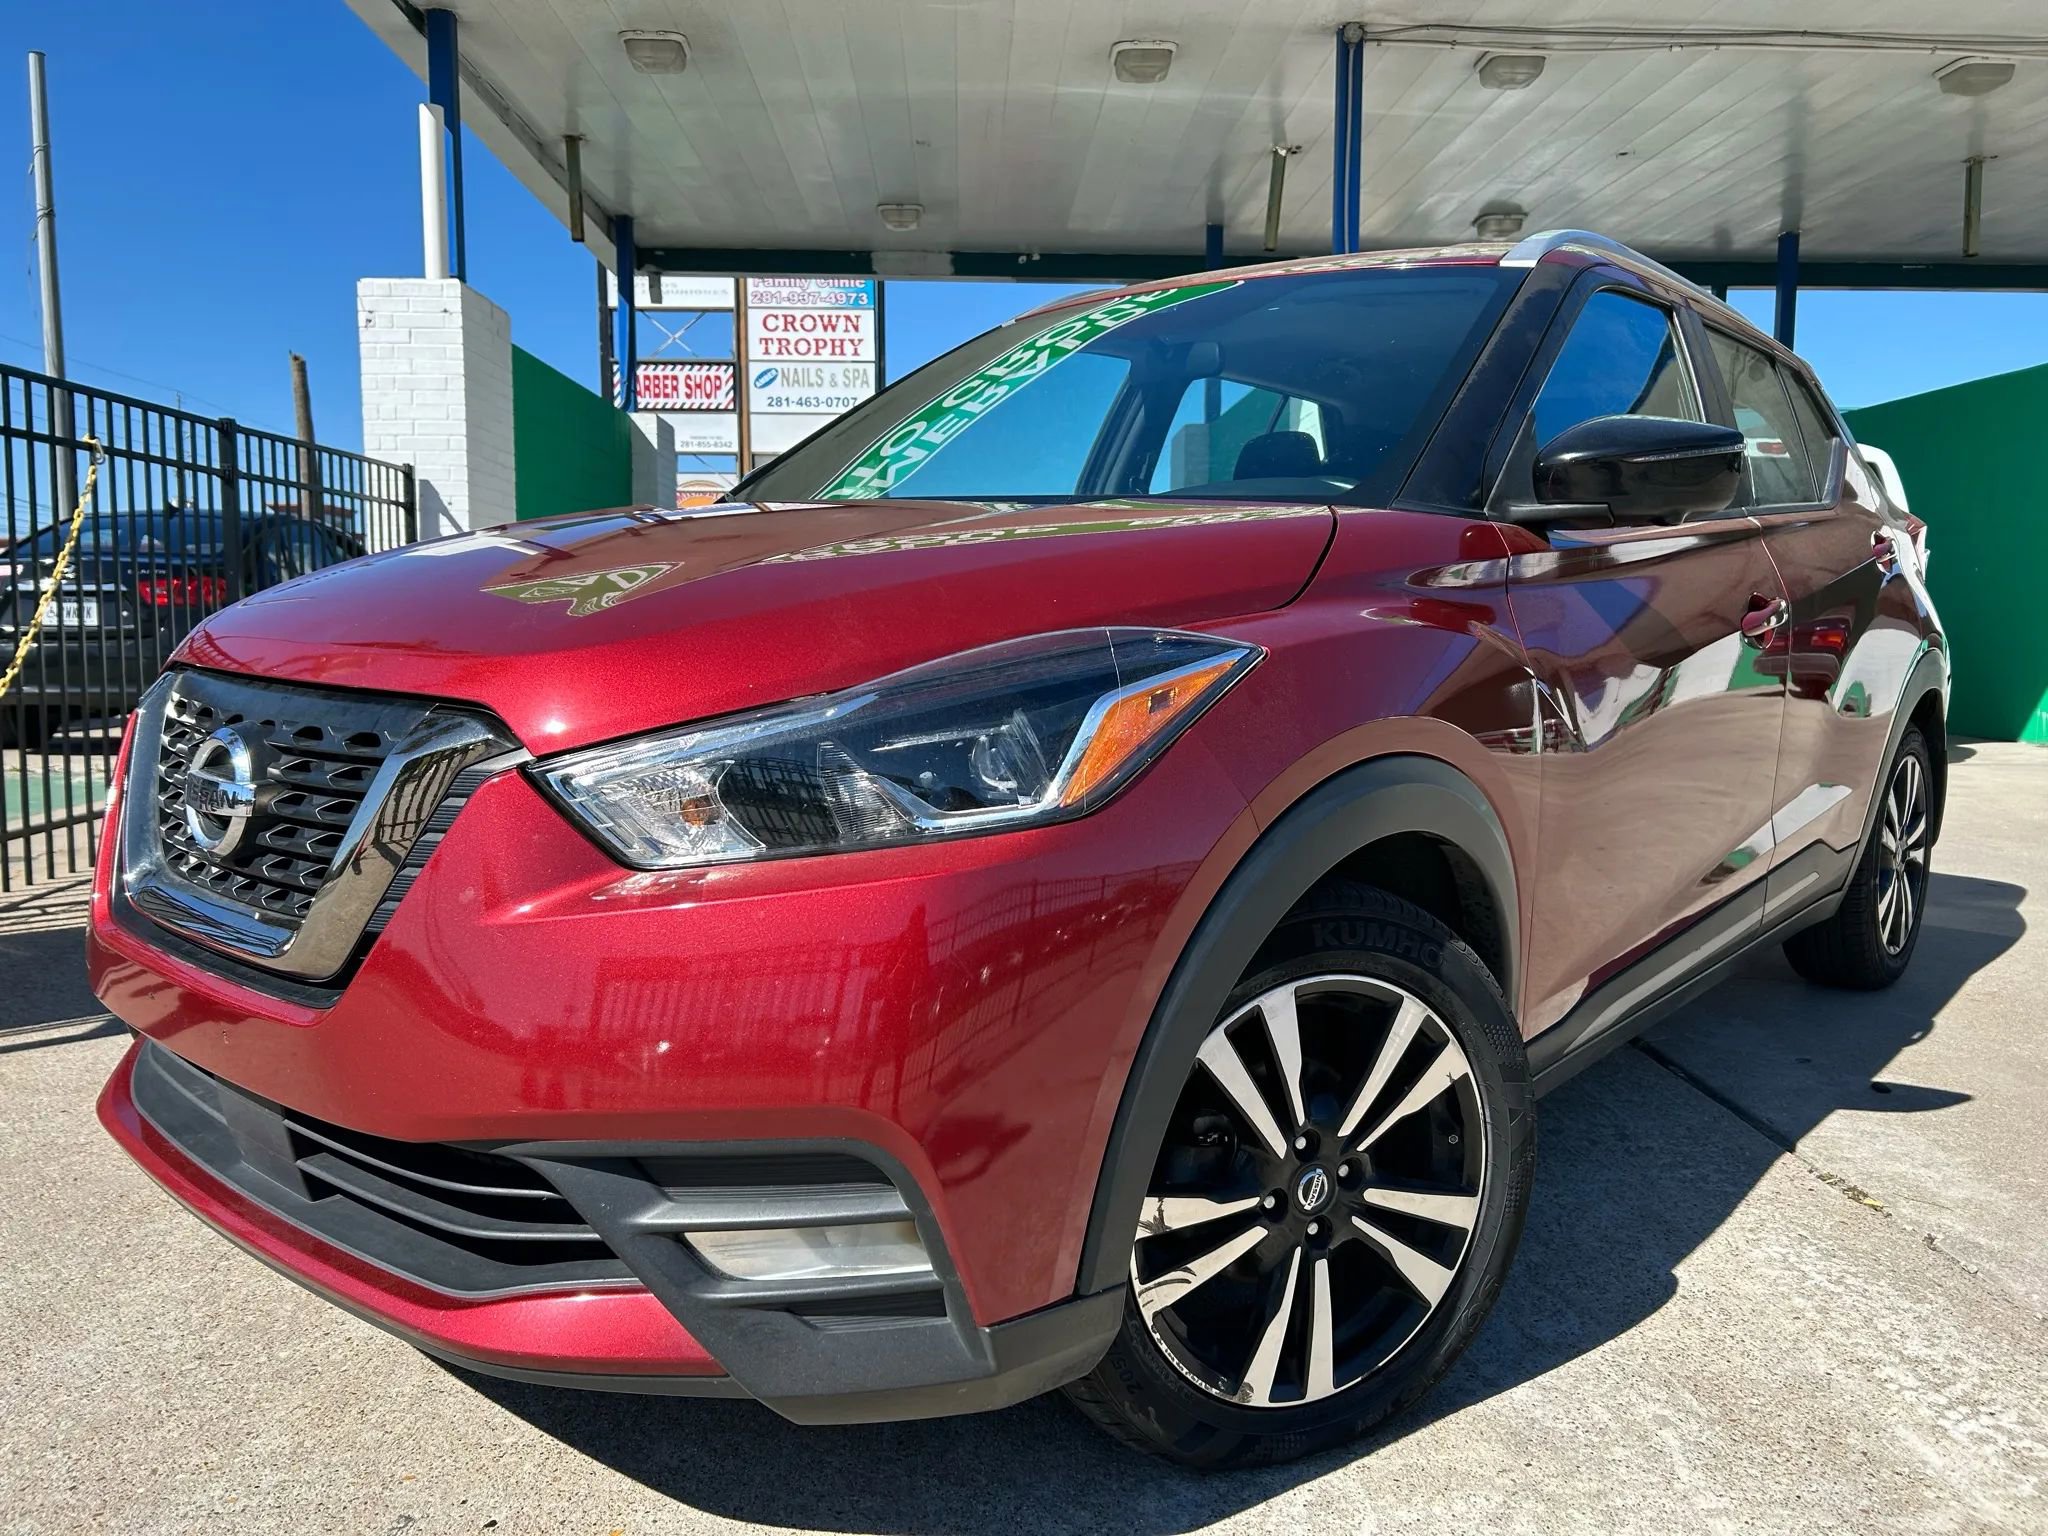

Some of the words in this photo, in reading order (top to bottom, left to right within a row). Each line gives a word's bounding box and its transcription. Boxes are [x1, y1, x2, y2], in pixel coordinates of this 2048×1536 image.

[751, 291, 868, 305] 281-937-4973
[762, 313, 862, 333] CROWN
[759, 337, 864, 357] TROPHY
[636, 374, 679, 399] ARBER
[684, 374, 723, 399] SHOP
[780, 367, 824, 388] NAILS
[829, 372, 838, 388] &
[843, 367, 870, 389] SPA
[767, 396, 858, 408] 281-463-0707
[1312, 919, 1446, 969] KUMHO
[1307, 1171, 1323, 1207] NISSAN
